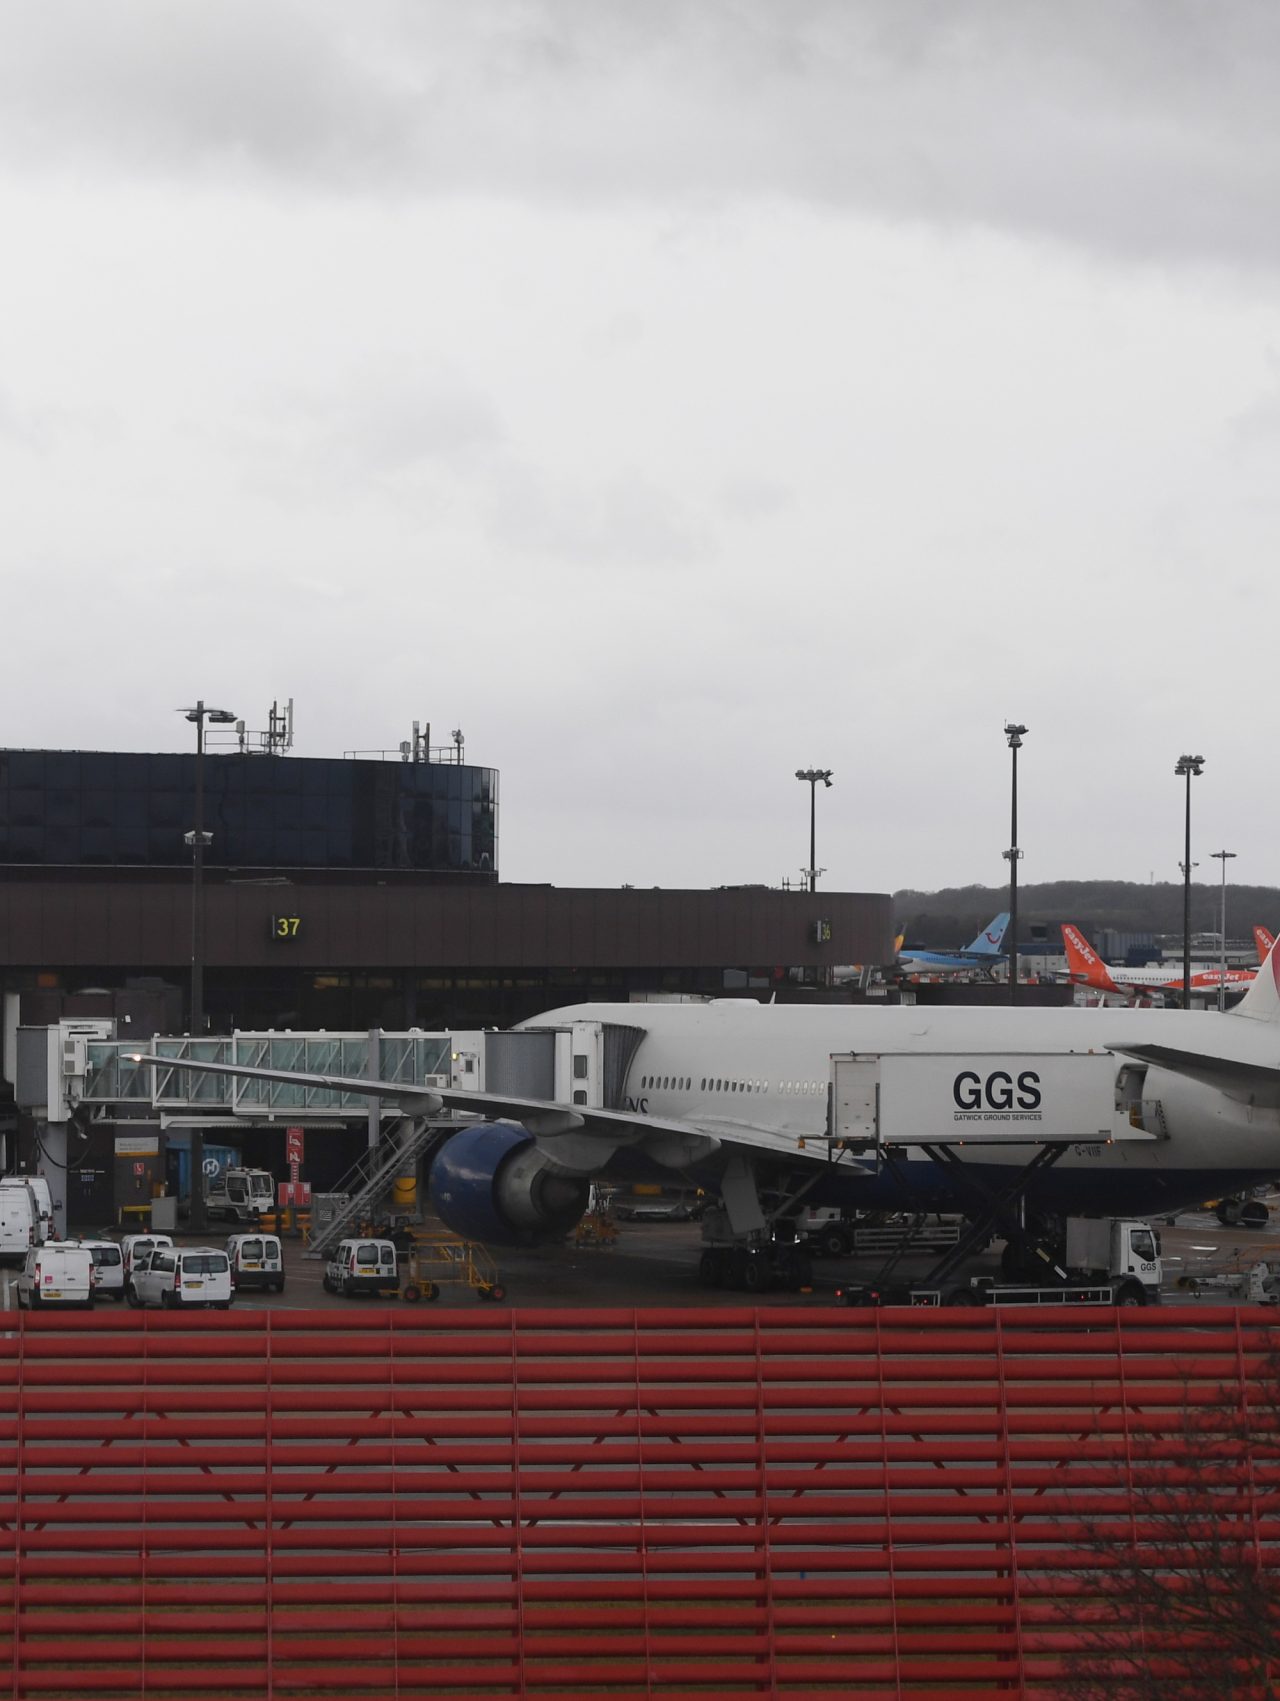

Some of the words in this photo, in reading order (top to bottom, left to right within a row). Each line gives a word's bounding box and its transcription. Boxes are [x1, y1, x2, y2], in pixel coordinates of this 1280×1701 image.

[277, 918, 300, 936] 37
[822, 923, 831, 940] 36
[1064, 927, 1096, 965] easyJet
[1256, 928, 1273, 949] easy
[1202, 972, 1240, 982] easyJet
[953, 1071, 1042, 1110] GGS
[1140, 1262, 1157, 1271] GGS
